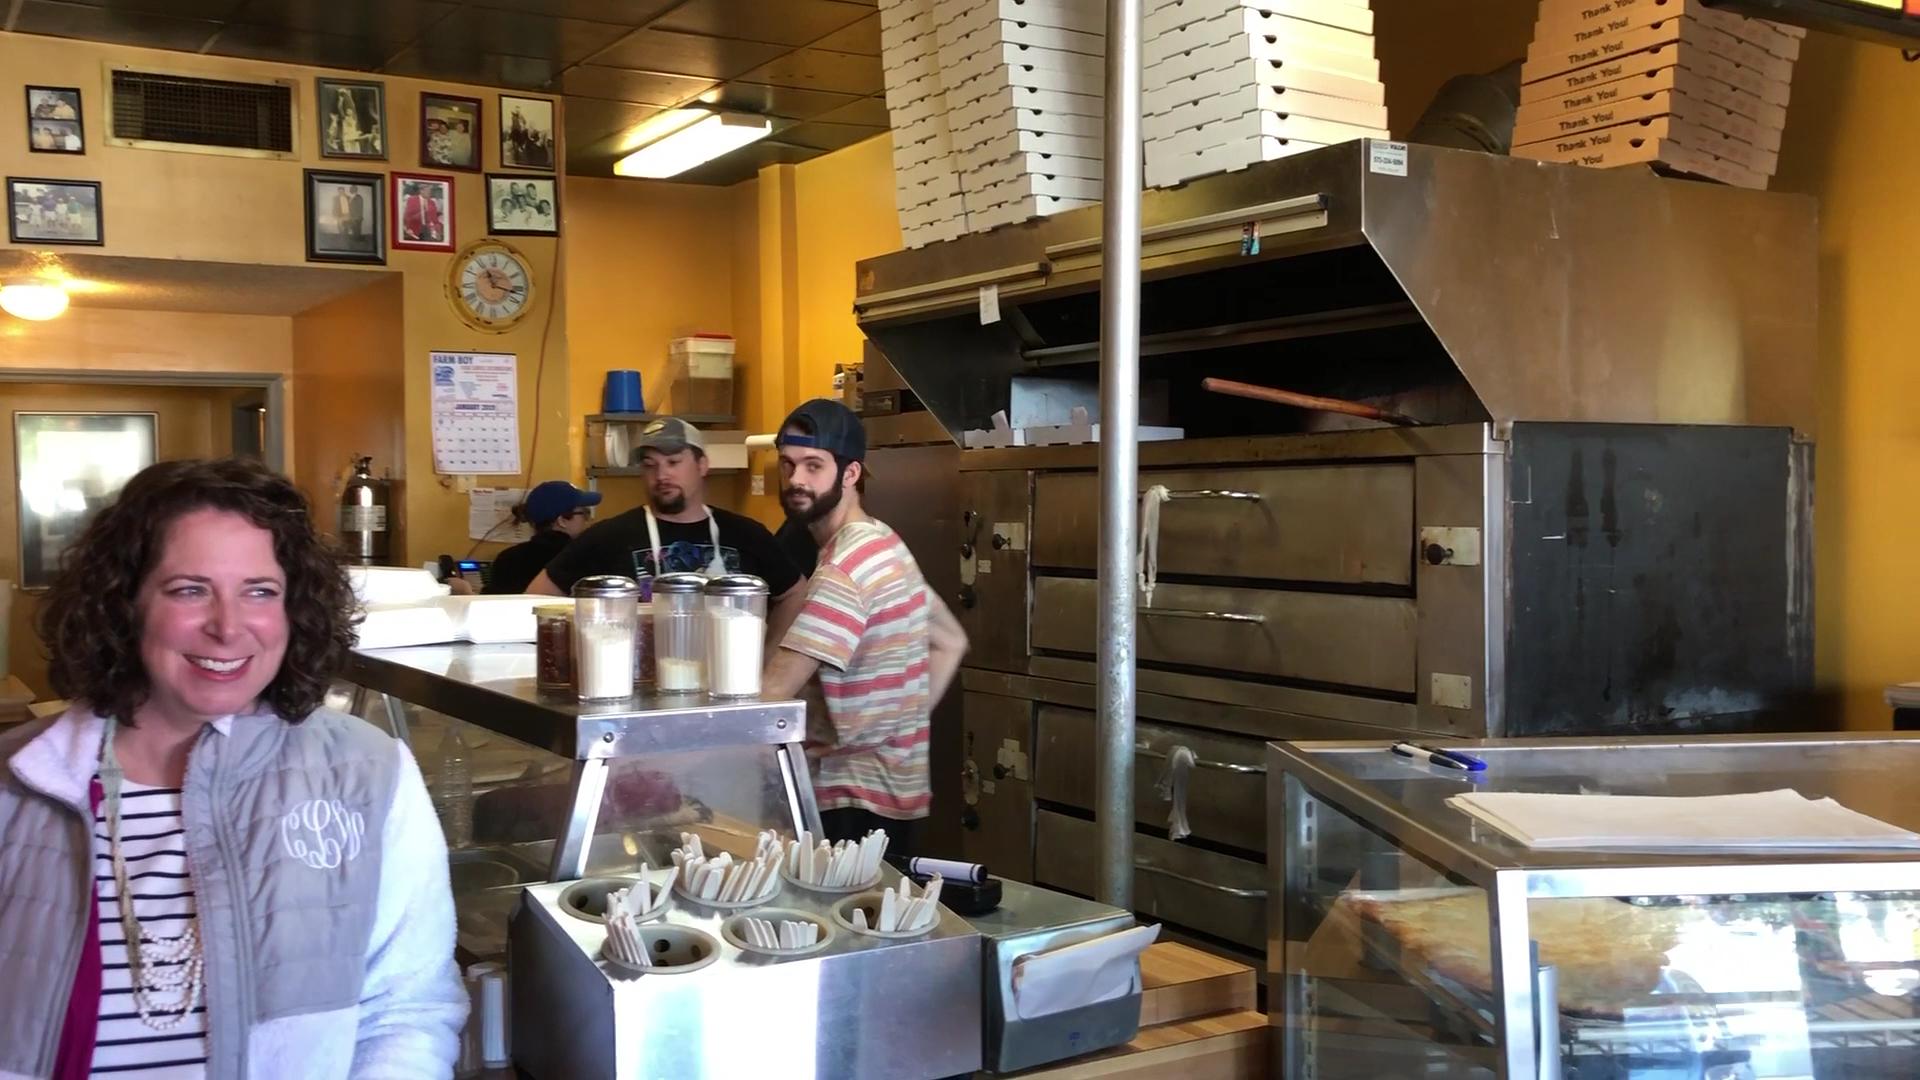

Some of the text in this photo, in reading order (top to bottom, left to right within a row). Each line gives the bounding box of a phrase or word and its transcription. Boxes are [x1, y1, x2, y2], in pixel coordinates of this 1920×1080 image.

[1581, 4, 1612, 20] Thank
[1574, 17, 1629, 42] Thank You!
[1568, 41, 1623, 64] Thank You!
[1566, 64, 1622, 87] Thank You!
[1563, 88, 1618, 109] Thank You!
[1559, 111, 1614, 131] Thank You!
[1556, 134, 1611, 152] Thank You!
[1582, 154, 1604, 165] You!
[433, 355, 456, 364] FARM
[458, 356, 474, 364] BOY
